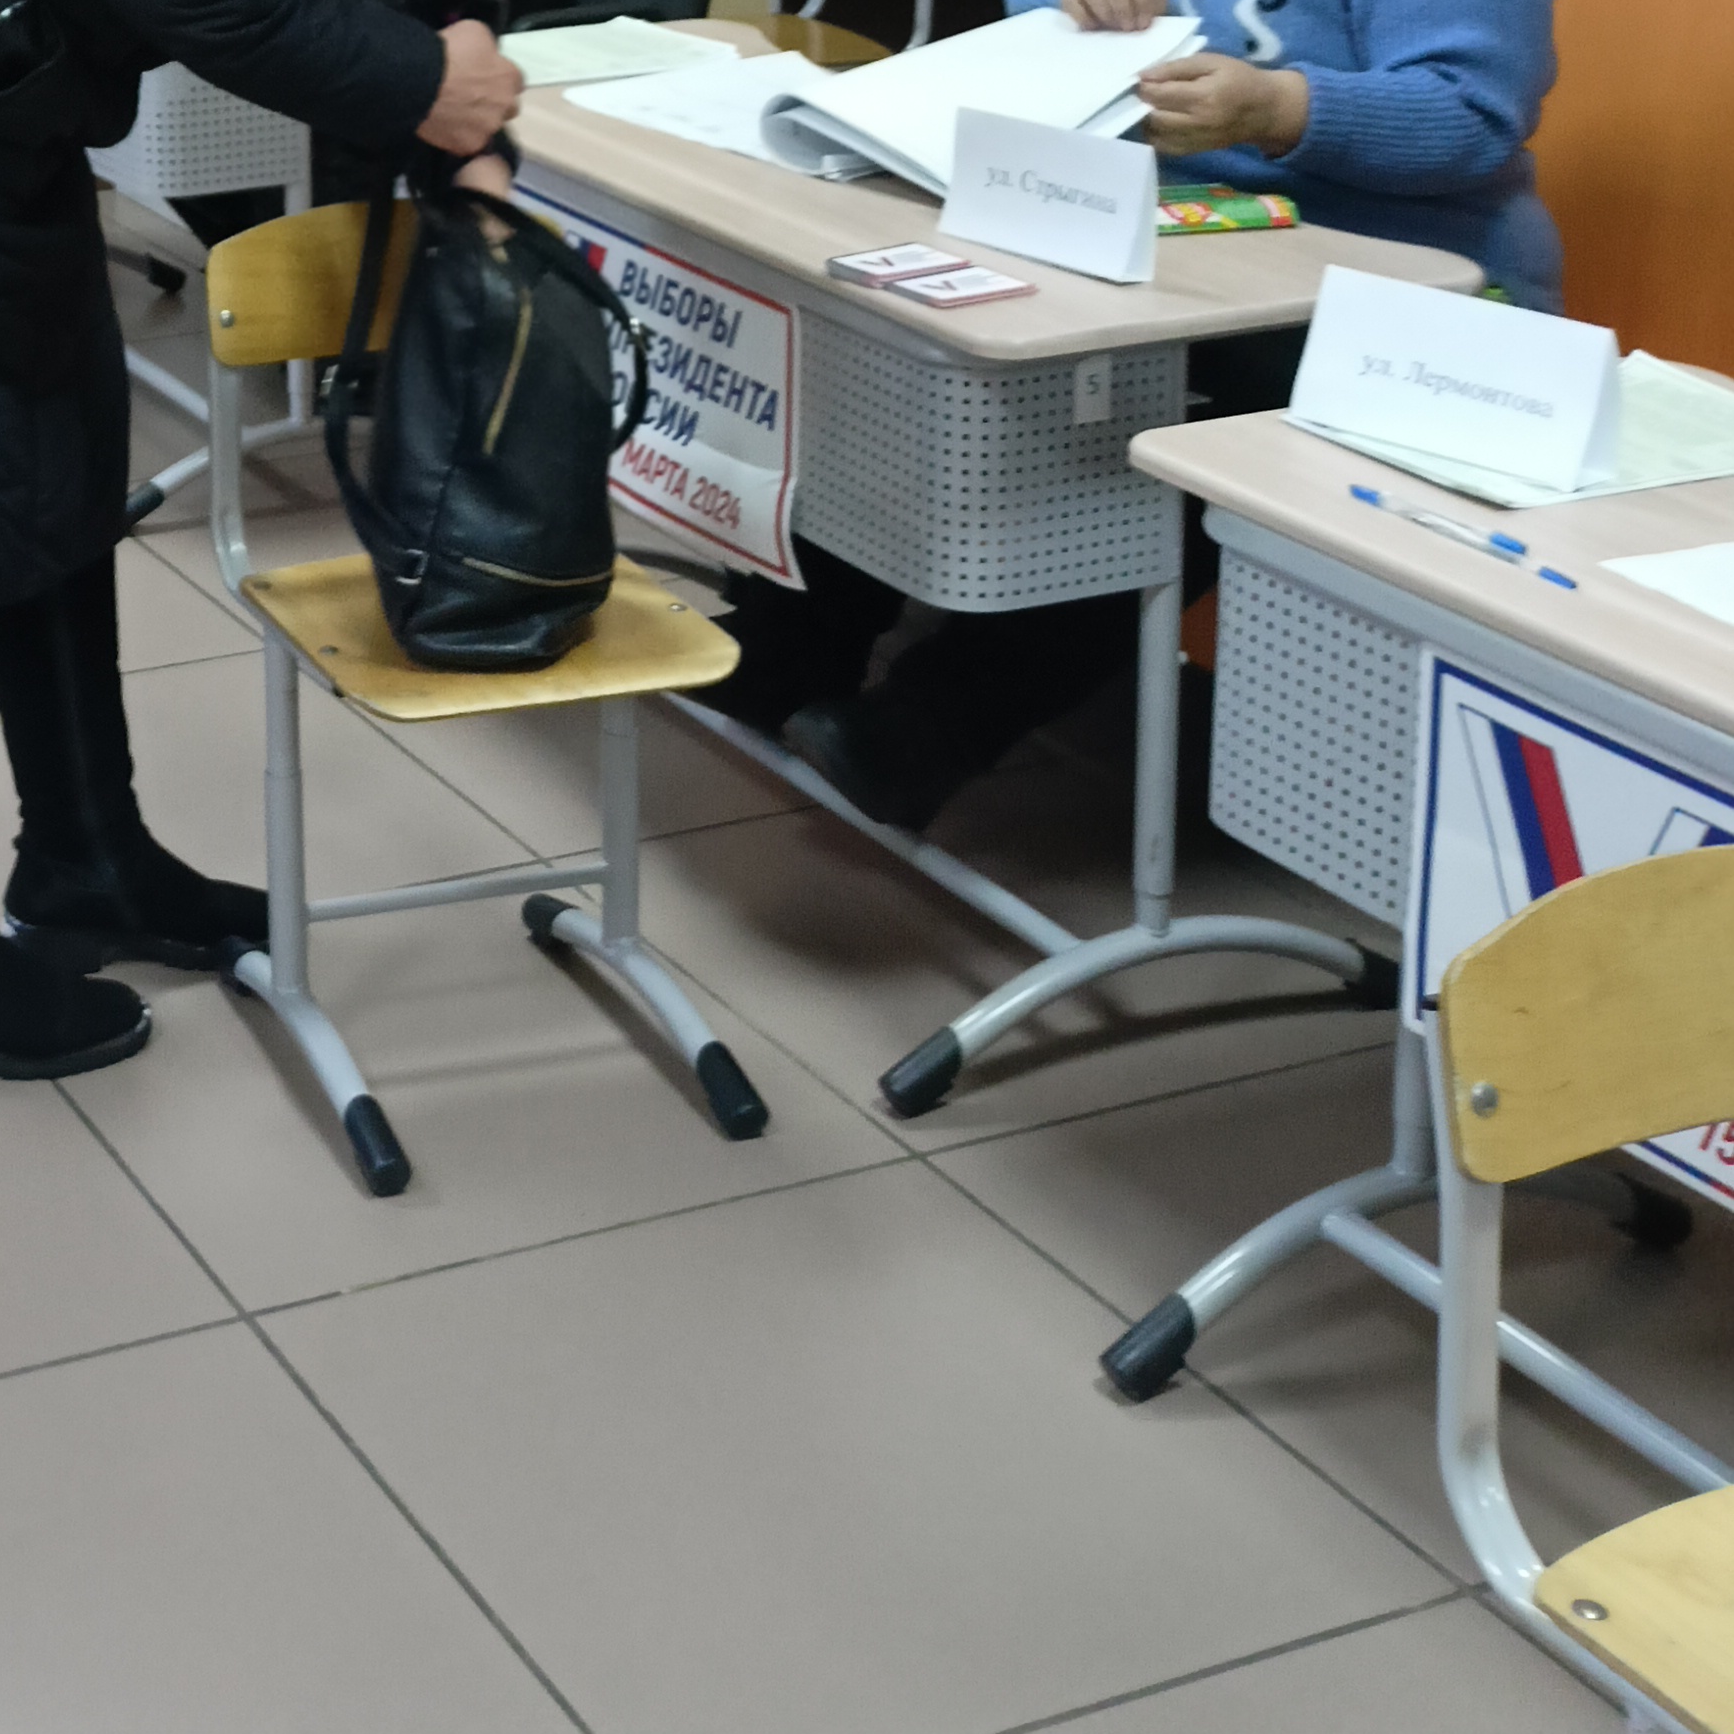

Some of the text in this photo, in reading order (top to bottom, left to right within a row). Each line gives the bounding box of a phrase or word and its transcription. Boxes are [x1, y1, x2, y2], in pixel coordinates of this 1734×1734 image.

[618, 258, 743, 349] ВЫБОРЫ
[611, 370, 700, 447] ОСИИ
[1358, 355, 1554, 419] ул. Лермонтова
[621, 437, 742, 530] МАРТА 2024
